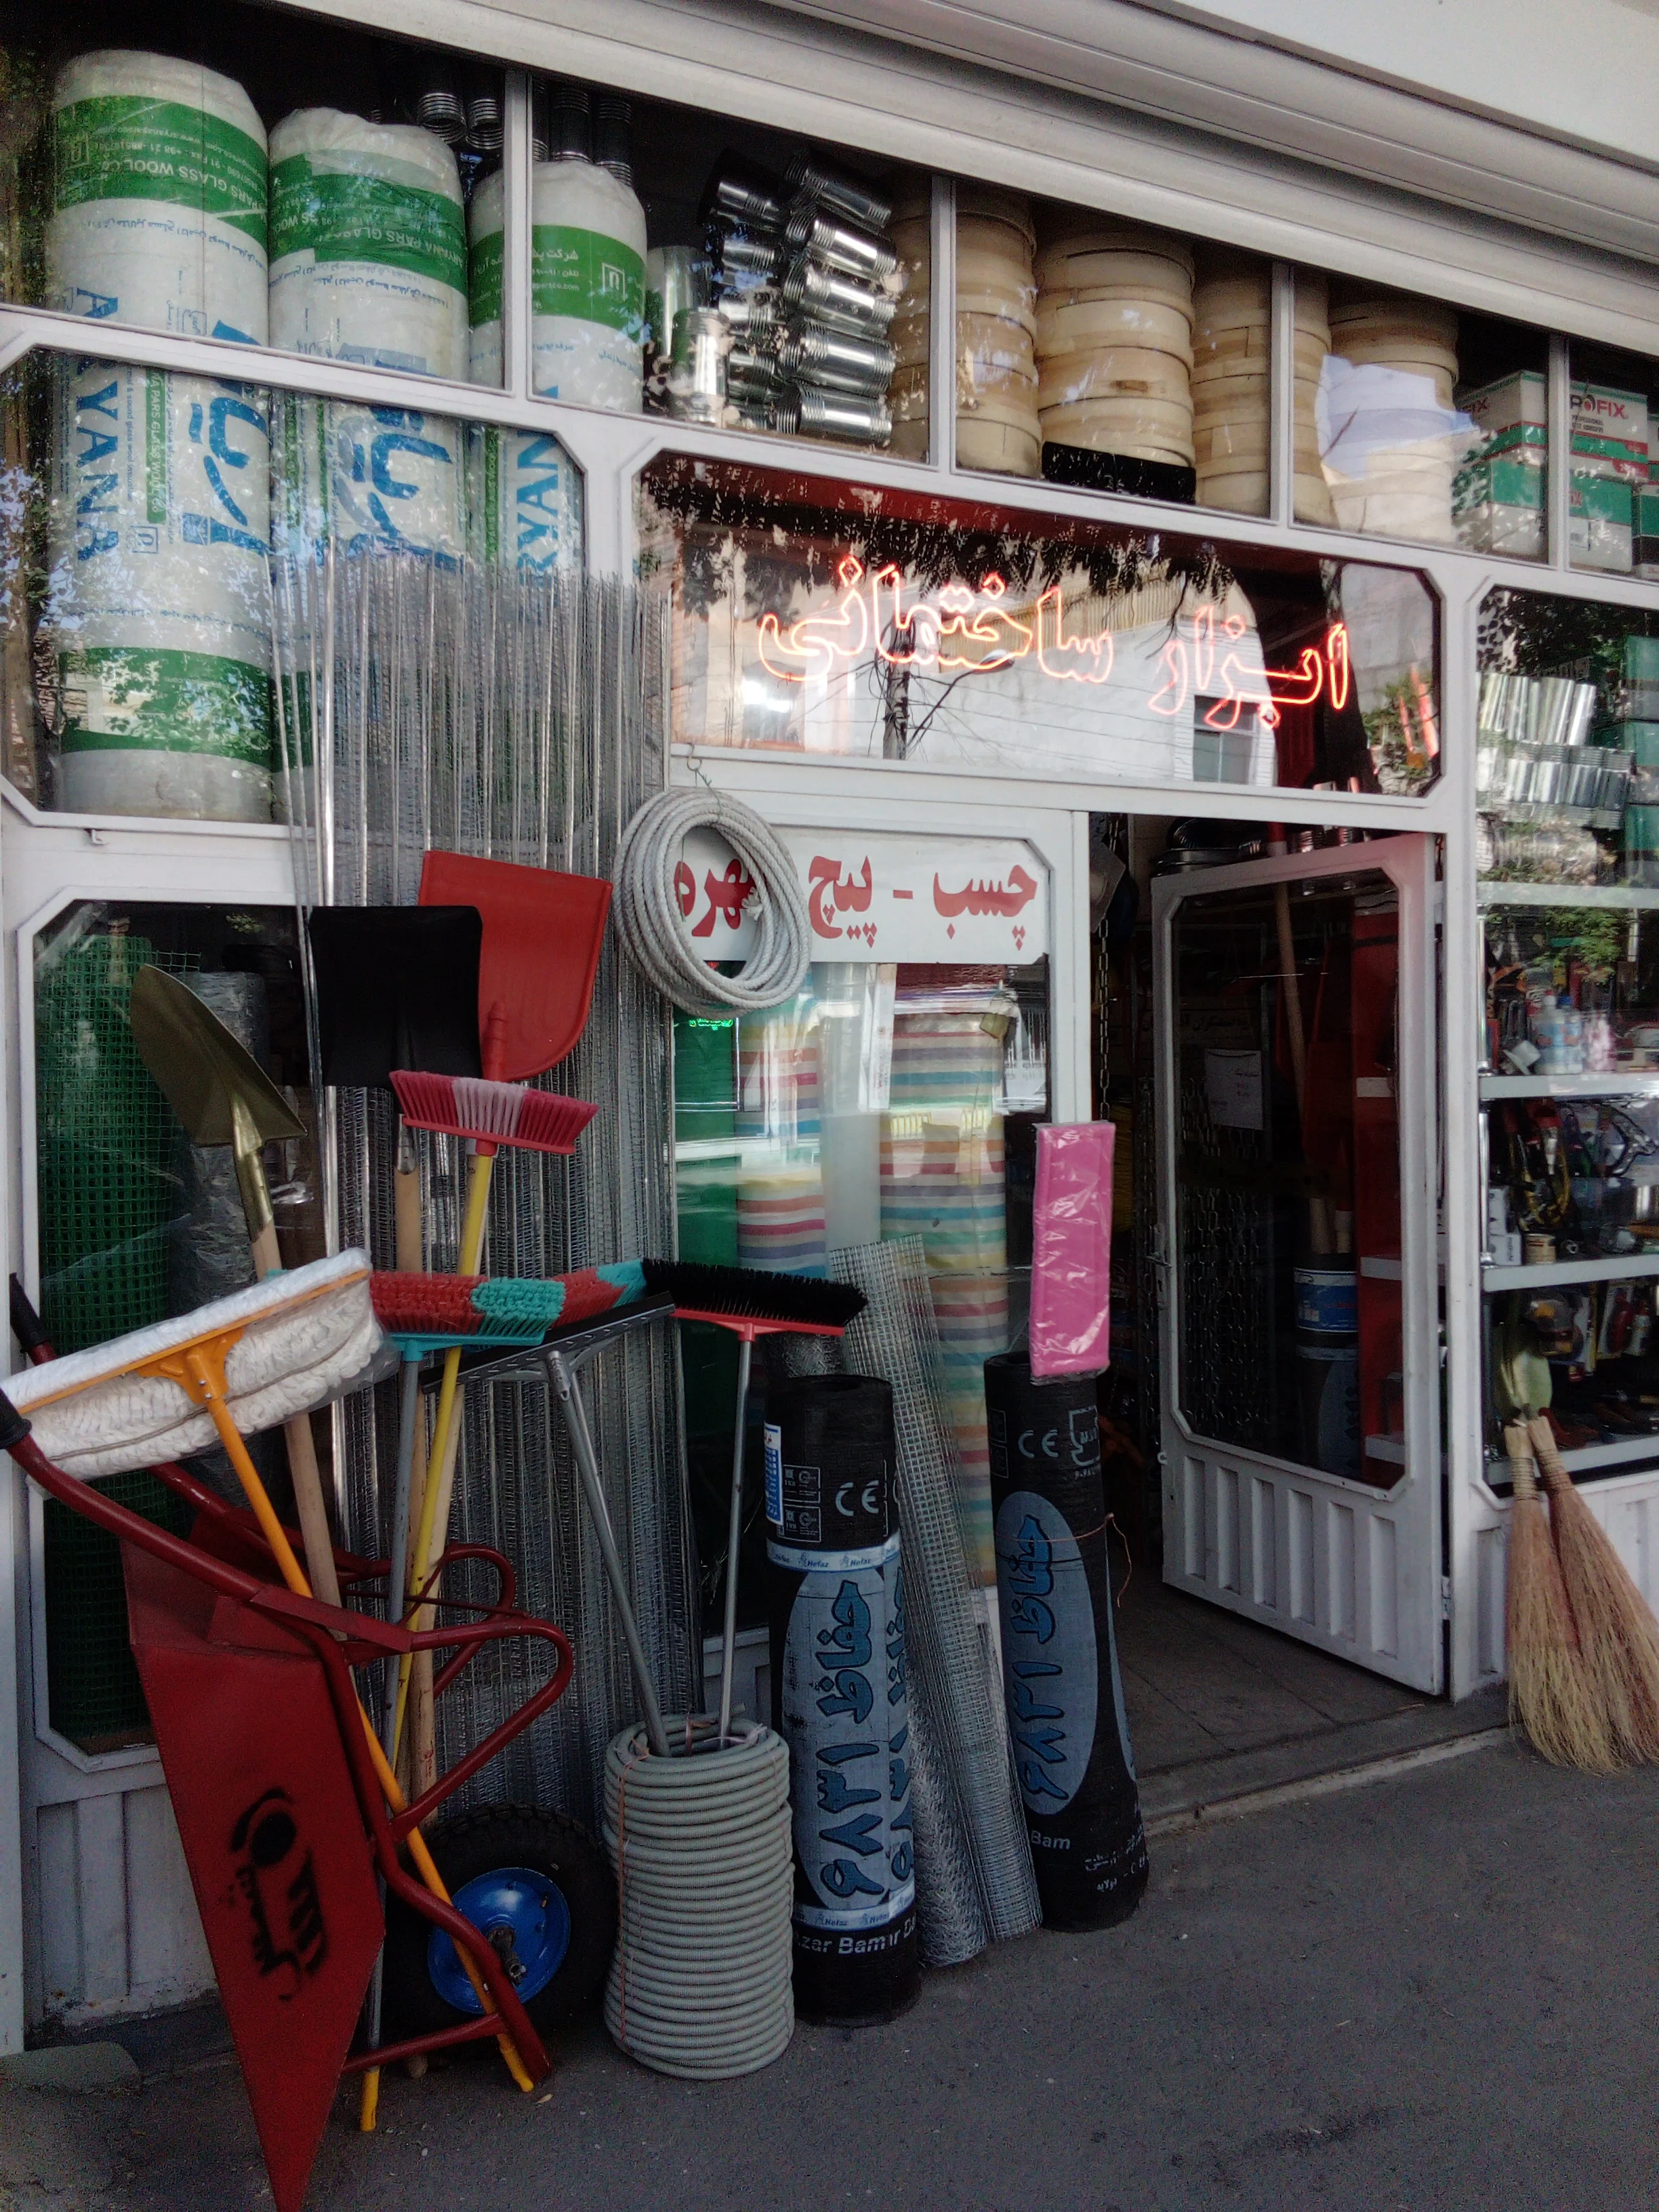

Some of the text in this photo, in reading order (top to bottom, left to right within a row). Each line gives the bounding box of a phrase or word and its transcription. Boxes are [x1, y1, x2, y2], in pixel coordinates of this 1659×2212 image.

[124, 159, 174, 176] WOOL
[178, 166, 227, 191] GLASS
[230, 184, 258, 209] PARS
[386, 230, 422, 248] PARS
[546, 249, 579, 262] شرکت
[150, 390, 161, 418] PARS
[1570, 394, 1629, 419] ROFIX
[123, 421, 134, 442] glass
[150, 422, 161, 458] GLASS
[150, 460, 163, 494] WOOL
[758, 554, 1349, 730] ابزار ساختمانی
[673, 857, 758, 939] هره
[808, 854, 878, 949] پیچ
[933, 864, 1038, 951] چسب
[1018, 1429, 1059, 1458] CE
[835, 1479, 880, 1516] CE
[1007, 1514, 1056, 1646] حفاظ
[815, 1580, 874, 1724] حفاظ
[1030, 1828, 1071, 1850] Bam
[838, 1934, 886, 1955] Bam
